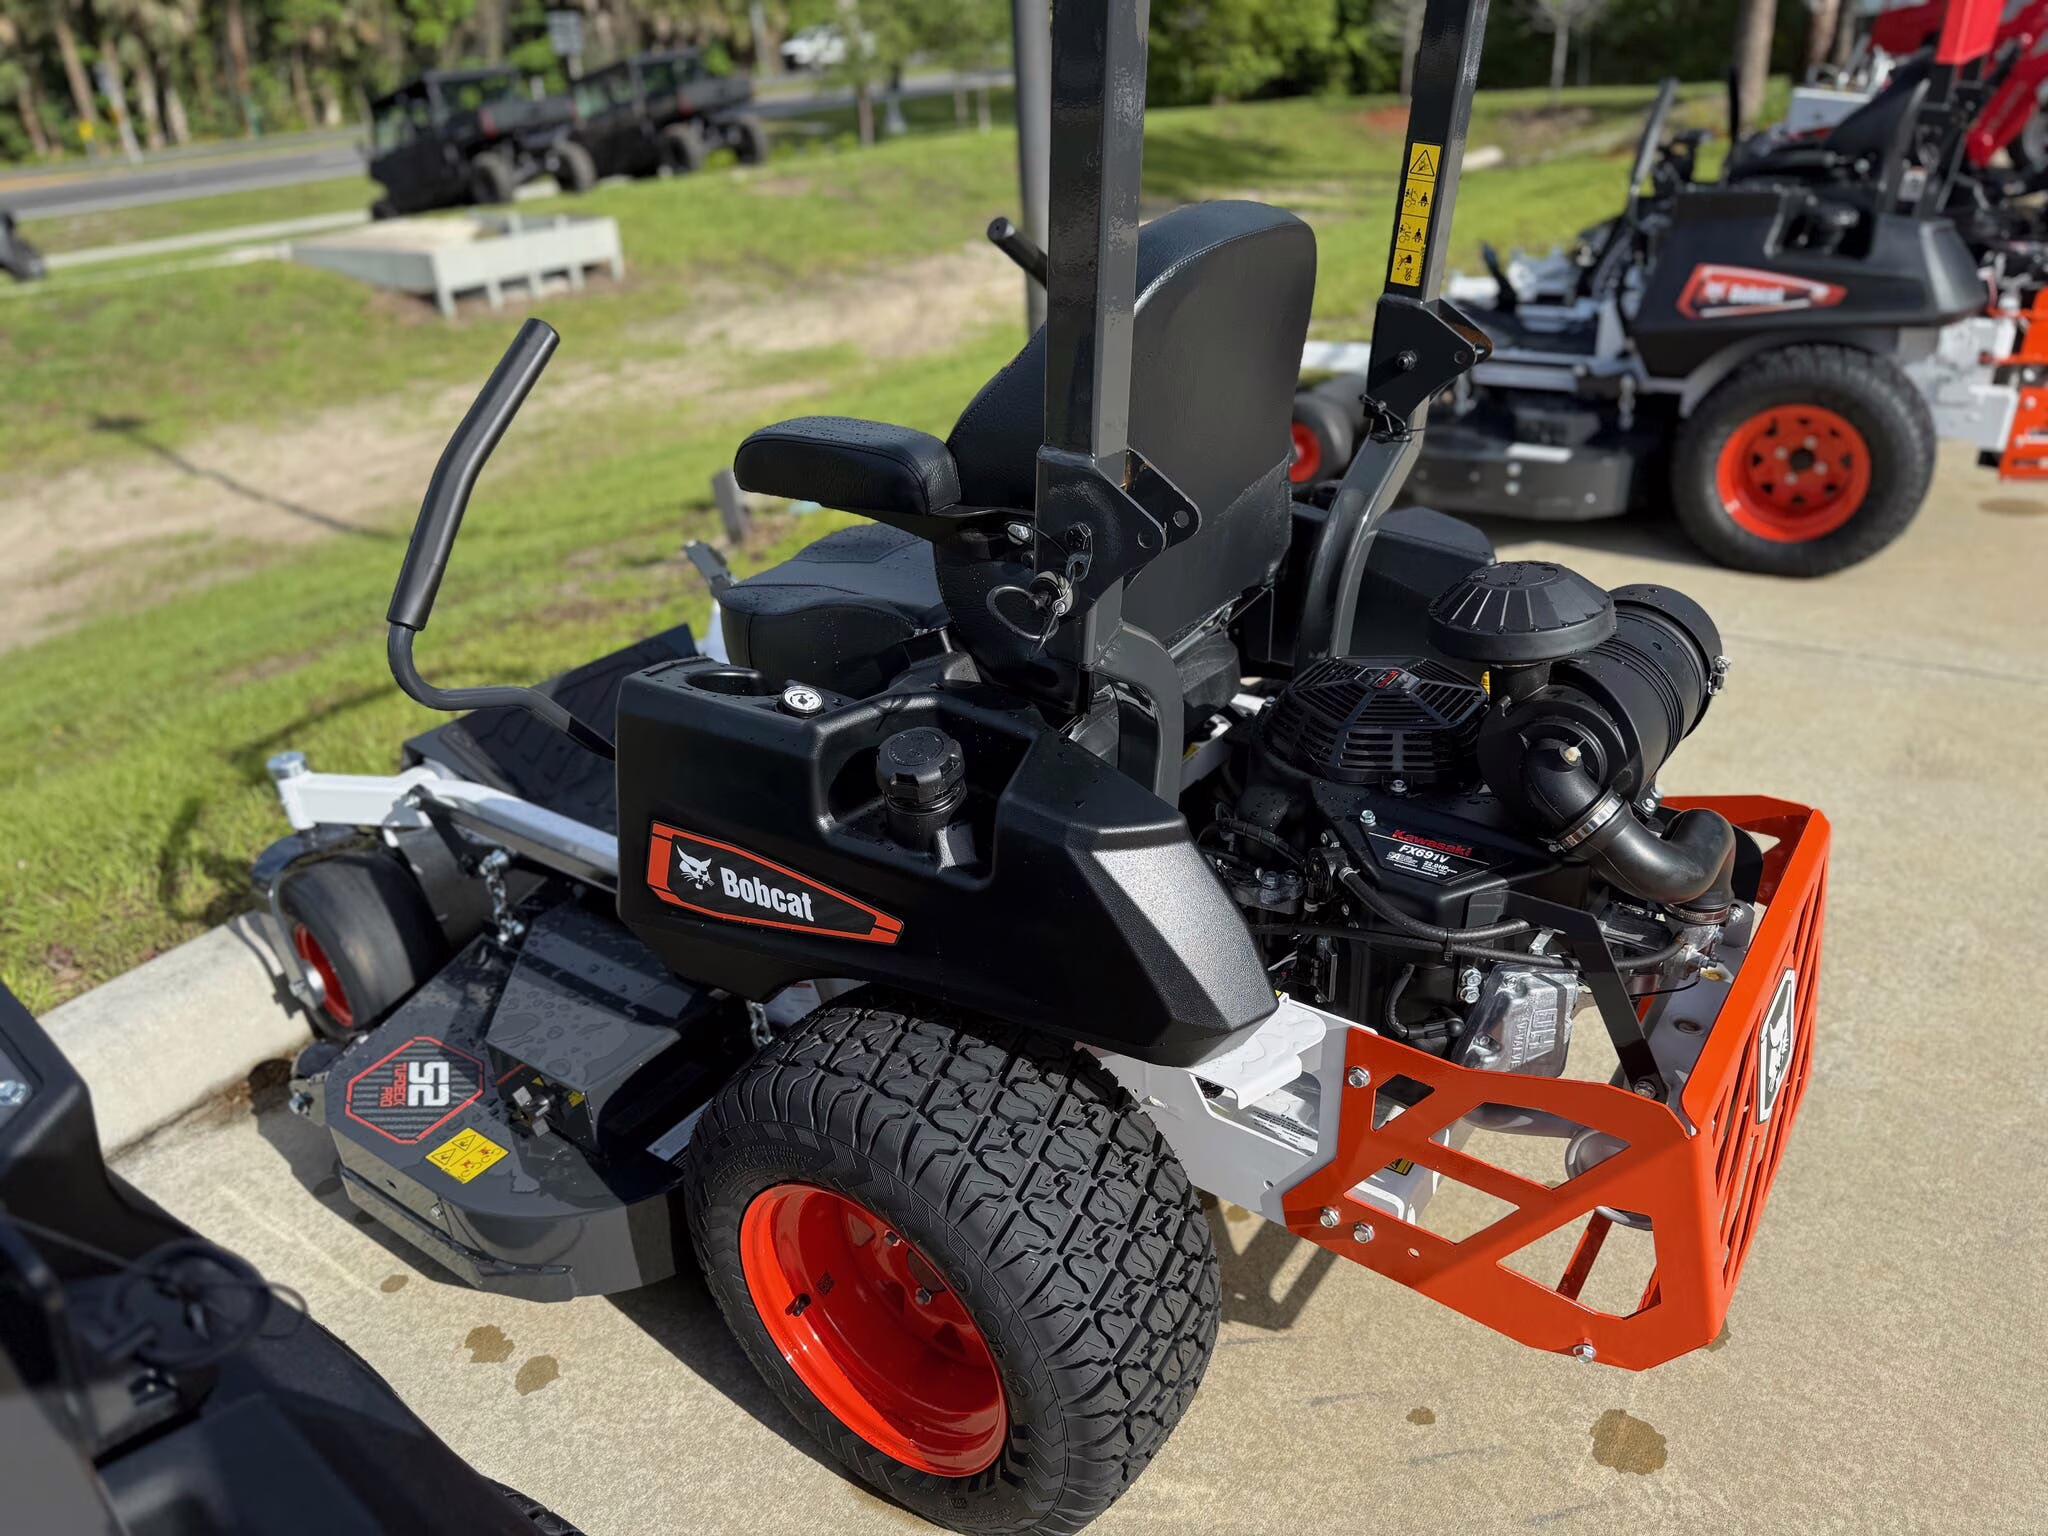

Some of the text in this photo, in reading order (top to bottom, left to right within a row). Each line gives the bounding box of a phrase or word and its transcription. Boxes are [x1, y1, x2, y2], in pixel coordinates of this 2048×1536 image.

[1392, 830, 1472, 857] Kawasaki
[1399, 844, 1450, 863] FX691V
[719, 866, 815, 922] Bobcat
[380, 1087, 393, 1108] PRO
[408, 1061, 450, 1107] 52
